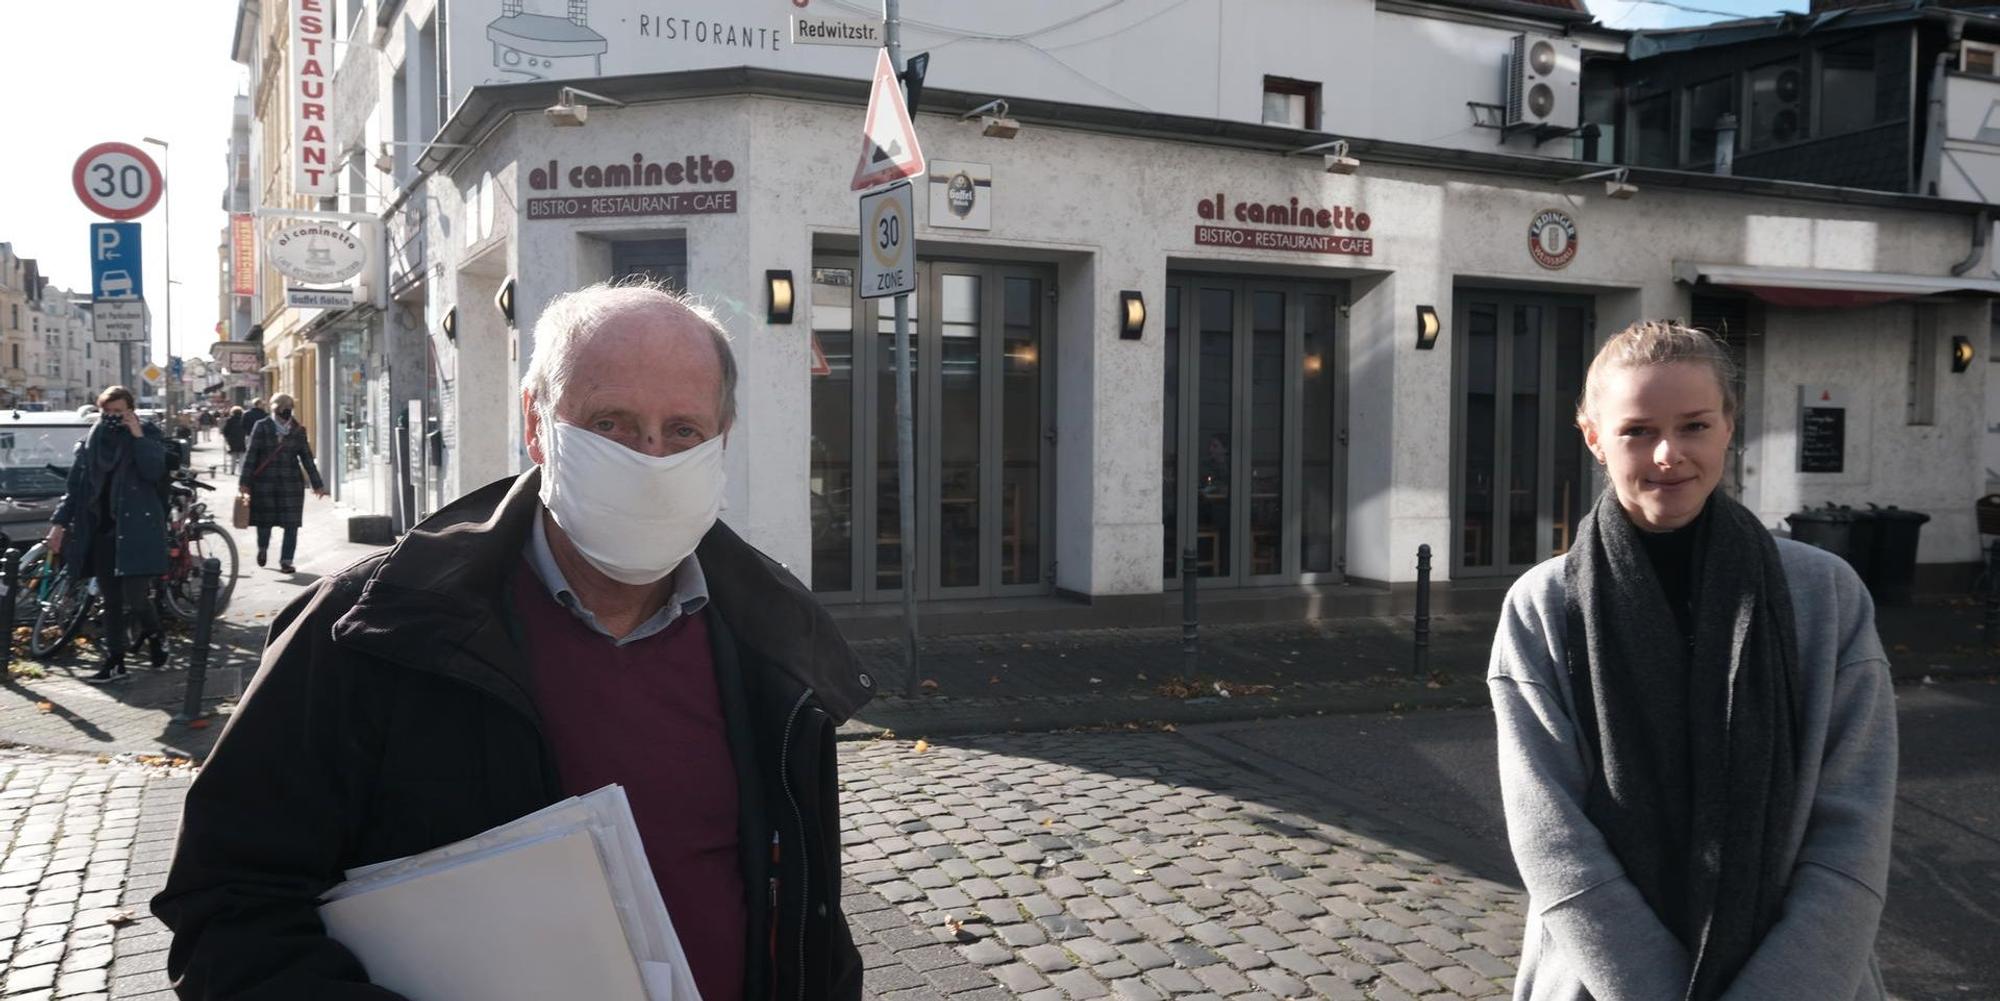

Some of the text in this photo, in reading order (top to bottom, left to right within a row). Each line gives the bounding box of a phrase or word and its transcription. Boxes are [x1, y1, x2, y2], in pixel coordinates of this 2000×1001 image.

[640, 14, 780, 51] RISTORANTE
[799, 20, 878, 40] Redwitzstr.
[92, 163, 143, 199] 30
[529, 152, 735, 190] al caminetto
[531, 200, 578, 216] BISTRO
[592, 196, 680, 213] RESTAURANT
[1197, 193, 1371, 231] al caminetto
[279, 226, 356, 250] al caminetto
[879, 215, 899, 249] 30
[1532, 212, 1574, 237] ERDINGER
[97, 228, 121, 260] P
[1200, 228, 1244, 245] BISTRO
[1256, 233, 1330, 250] RESTAURANT
[877, 269, 904, 290] ZONE
